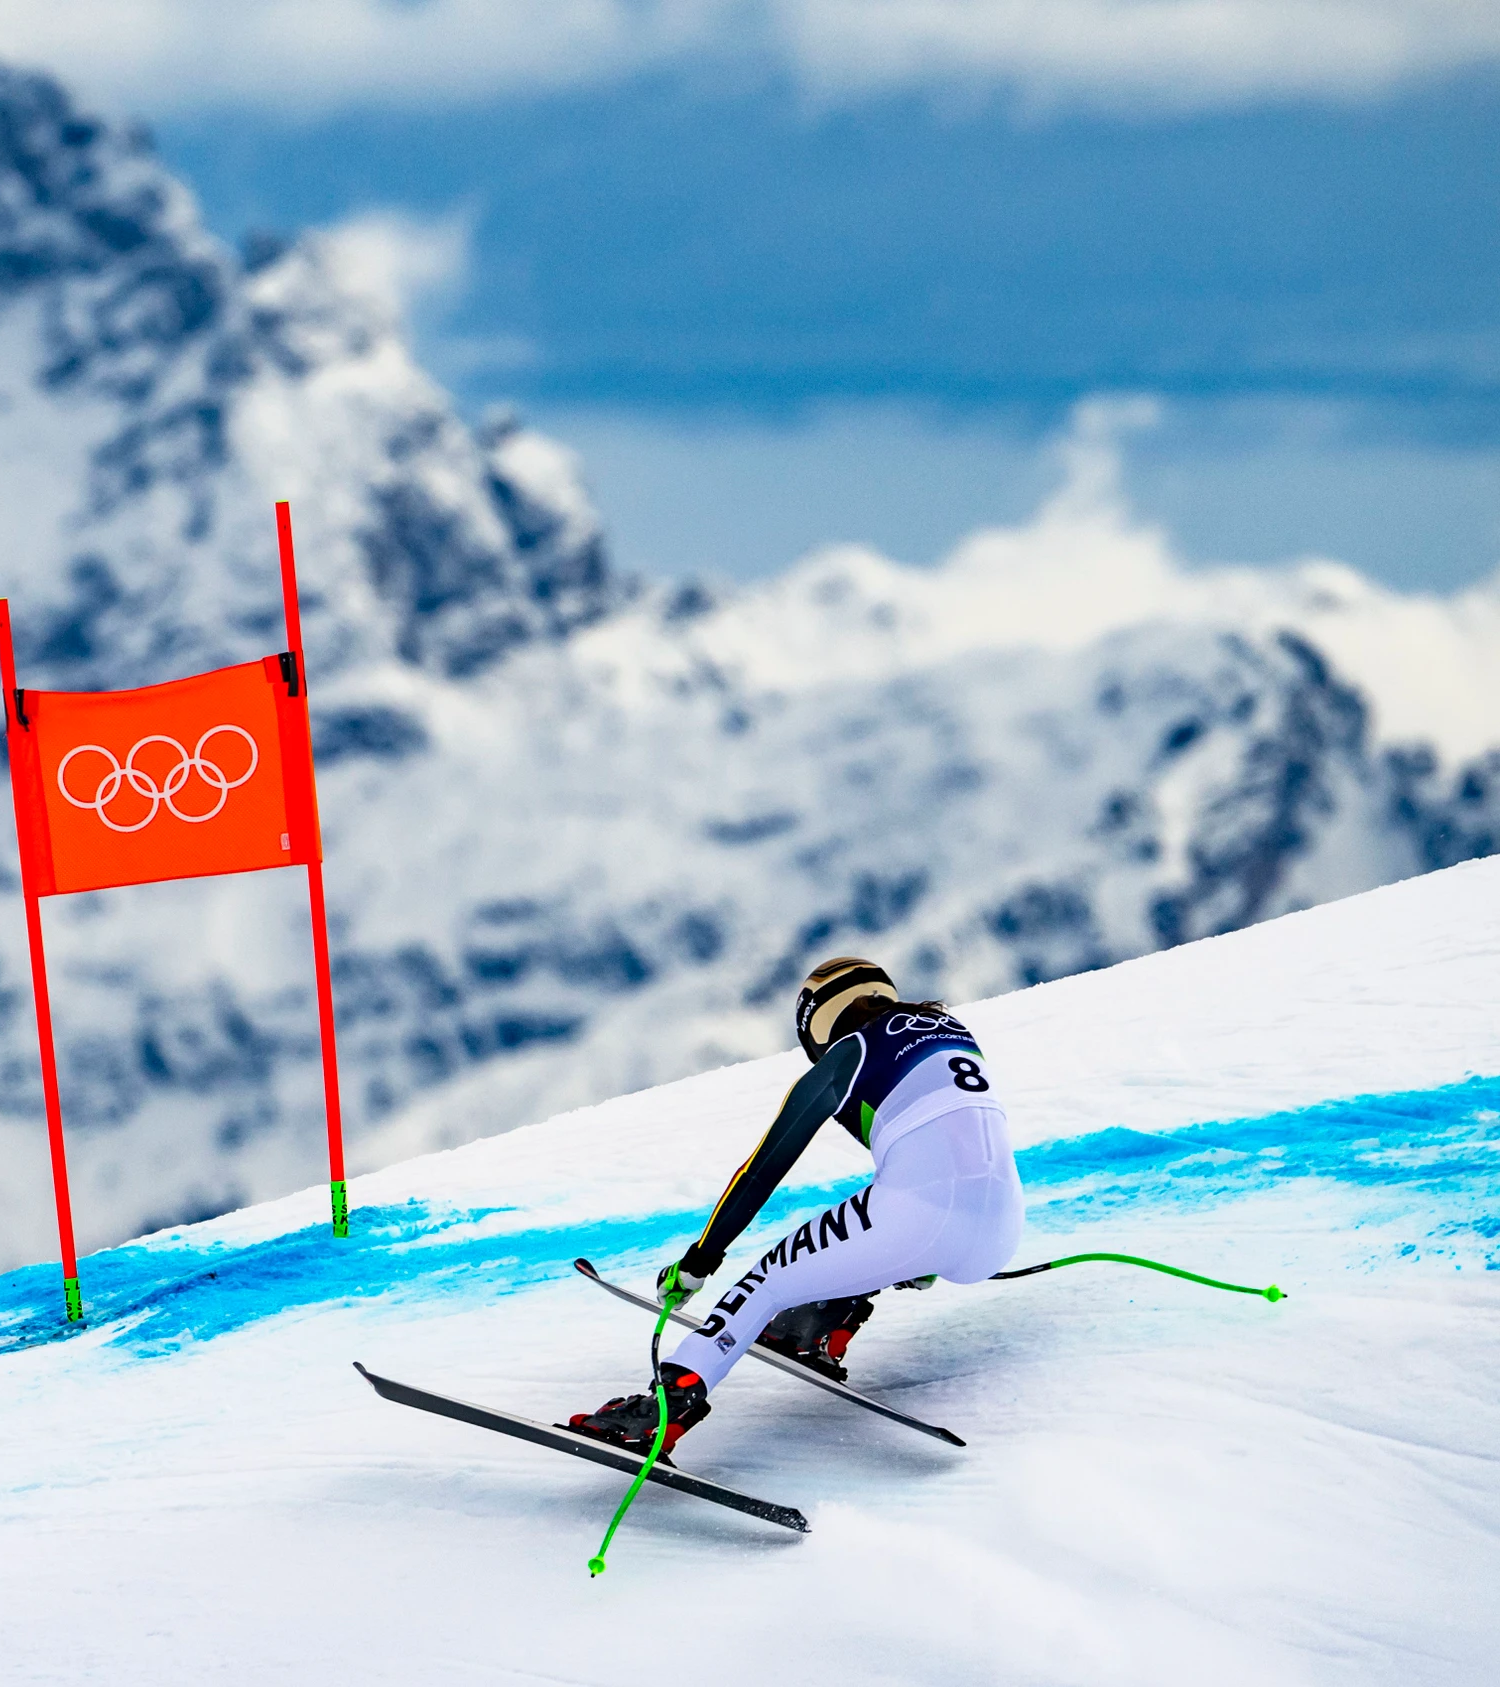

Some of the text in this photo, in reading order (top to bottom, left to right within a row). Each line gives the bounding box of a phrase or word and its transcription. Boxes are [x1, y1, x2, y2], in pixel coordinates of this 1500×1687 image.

[800, 998, 816, 1032] uvex
[894, 1033, 937, 1061] MILANO
[948, 1056, 990, 1093] 8
[340, 1183, 348, 1235] LISKI
